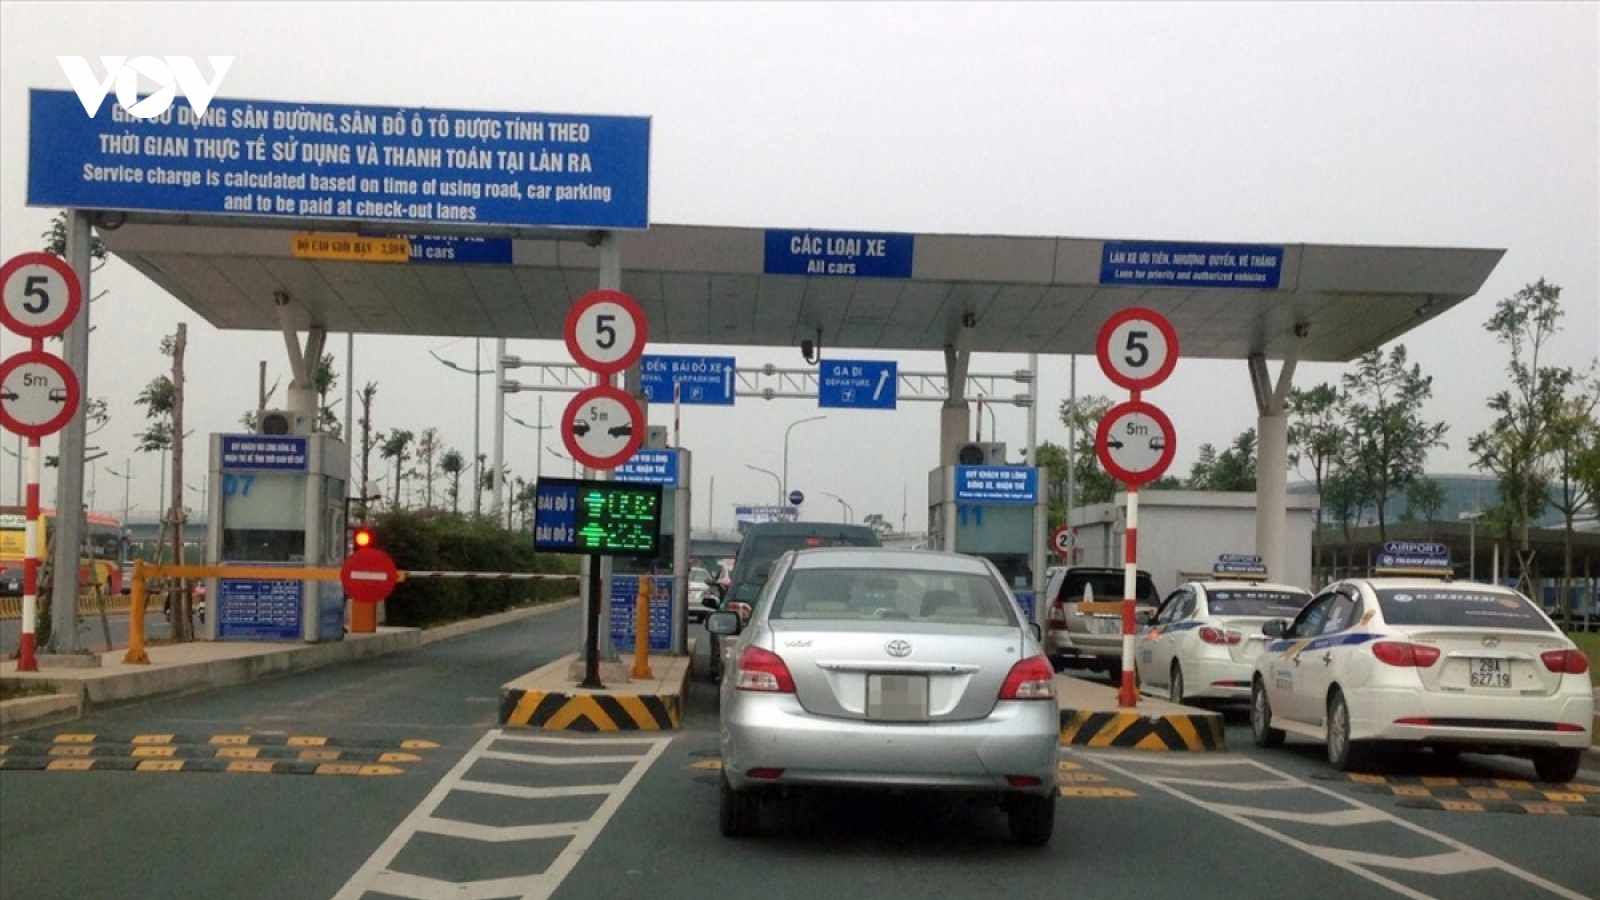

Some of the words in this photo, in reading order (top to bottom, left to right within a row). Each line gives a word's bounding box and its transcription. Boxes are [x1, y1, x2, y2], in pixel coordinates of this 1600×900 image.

[232, 104, 268, 129] SÂN
[340, 110, 377, 135] SÂN
[428, 113, 449, 138] TÔ
[454, 117, 501, 143] ĐƯỢC
[504, 116, 544, 141] TÍNH
[548, 122, 590, 143] THEO
[99, 130, 141, 156] THỜI
[144, 136, 188, 158] GIAN
[194, 138, 240, 164] THỰC
[246, 135, 267, 161] TẾ
[271, 134, 299, 162] SỬ
[302, 143, 351, 168] DỤNG
[356, 142, 380, 166] VÀ
[384, 147, 441, 169] THANH
[446, 146, 492, 170] TOÁN
[497, 151, 525, 174] TẠI
[529, 148, 563, 173] LÀN
[568, 152, 592, 173] RA
[83, 163, 144, 183] Service
[147, 166, 201, 188] charge
[206, 169, 220, 186] is
[224, 170, 306, 191] calculated
[310, 174, 356, 193] based
[360, 178, 379, 194] on
[383, 177, 418, 195] time
[422, 177, 437, 195] of
[439, 180, 481, 200] using
[484, 181, 522, 201] road,
[527, 184, 551, 199] car
[555, 182, 613, 203] parking
[224, 194, 254, 212] and
[255, 196, 271, 212] to
[275, 195, 296, 213] be
[300, 197, 332, 216] paid
[337, 200, 352, 216] at
[356, 200, 434, 218] check-out
[437, 202, 477, 220] lanes
[426, 247, 456, 260] cars
[791, 233, 823, 256] CÁC
[827, 238, 860, 260] LOẠI
[866, 239, 886, 257] XE
[807, 259, 825, 274] All
[828, 262, 857, 275] cars
[23, 275, 50, 315] 5
[595, 314, 617, 349] 5
[1124, 331, 1149, 368] 5
[710, 362, 722, 373] XE
[832, 365, 849, 377] GA
[23, 373, 49, 388] 5m
[1126, 422, 1149, 436] 5m
[222, 472, 256, 498] 07
[569, 497, 575, 512] 1
[567, 527, 574, 543] 2
[1390, 543, 1443, 553] AIRPORT
